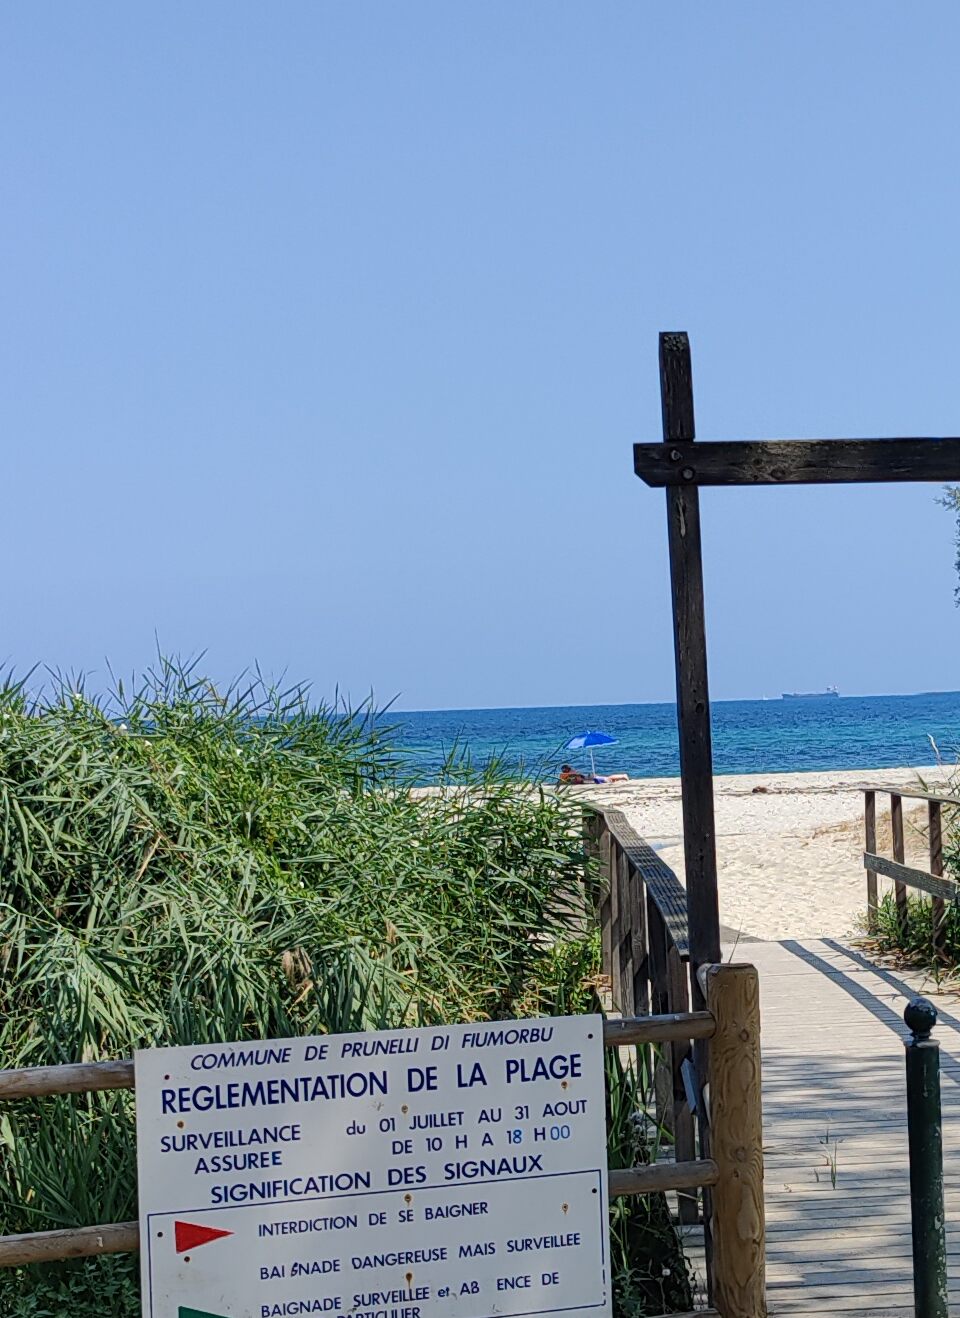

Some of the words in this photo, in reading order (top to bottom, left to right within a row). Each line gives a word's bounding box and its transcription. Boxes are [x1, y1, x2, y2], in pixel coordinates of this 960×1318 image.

[191, 1048, 291, 1070] COMMUNE
[304, 1044, 329, 1061] DE
[341, 1037, 419, 1059] PRUNELLI
[431, 1035, 450, 1051] DI
[461, 1027, 553, 1049] FIUMORBU
[161, 1071, 388, 1114] REGLEMENTATION
[407, 1066, 438, 1093] DE
[457, 1062, 488, 1088] LA
[506, 1053, 582, 1084] PLAGE
[346, 1120, 366, 1136] du
[379, 1117, 396, 1133] 01
[409, 1111, 464, 1130] JUILLET
[478, 1108, 502, 1124] AU
[514, 1105, 530, 1121] 31
[542, 1100, 587, 1118] AOUT
[160, 1125, 301, 1153] SURVEILLANCE
[392, 1139, 413, 1155] DE
[426, 1137, 443, 1153] 10
[455, 1134, 468, 1150] H
[481, 1133, 494, 1147] A
[507, 1129, 522, 1144] 18
[194, 1151, 282, 1175] ASSUREE
[211, 1171, 371, 1204] SIGNIFICATION
[388, 1165, 427, 1186] DES
[444, 1154, 543, 1180] SIGNAUX
[258, 1215, 358, 1237] INTERDICTION
[368, 1212, 387, 1226] DE
[398, 1209, 414, 1223] SE
[425, 1201, 488, 1221] BAIGNER
[351, 1248, 448, 1270] DANGEREUSE
[458, 1242, 496, 1259] MAIS
[506, 1232, 581, 1253] SURVEILLEE
[261, 1297, 342, 1318] BAIGNADE
[353, 1286, 430, 1308] SURVEILLEE
[437, 1286, 450, 1298] et
[541, 1272, 559, 1286] DE
